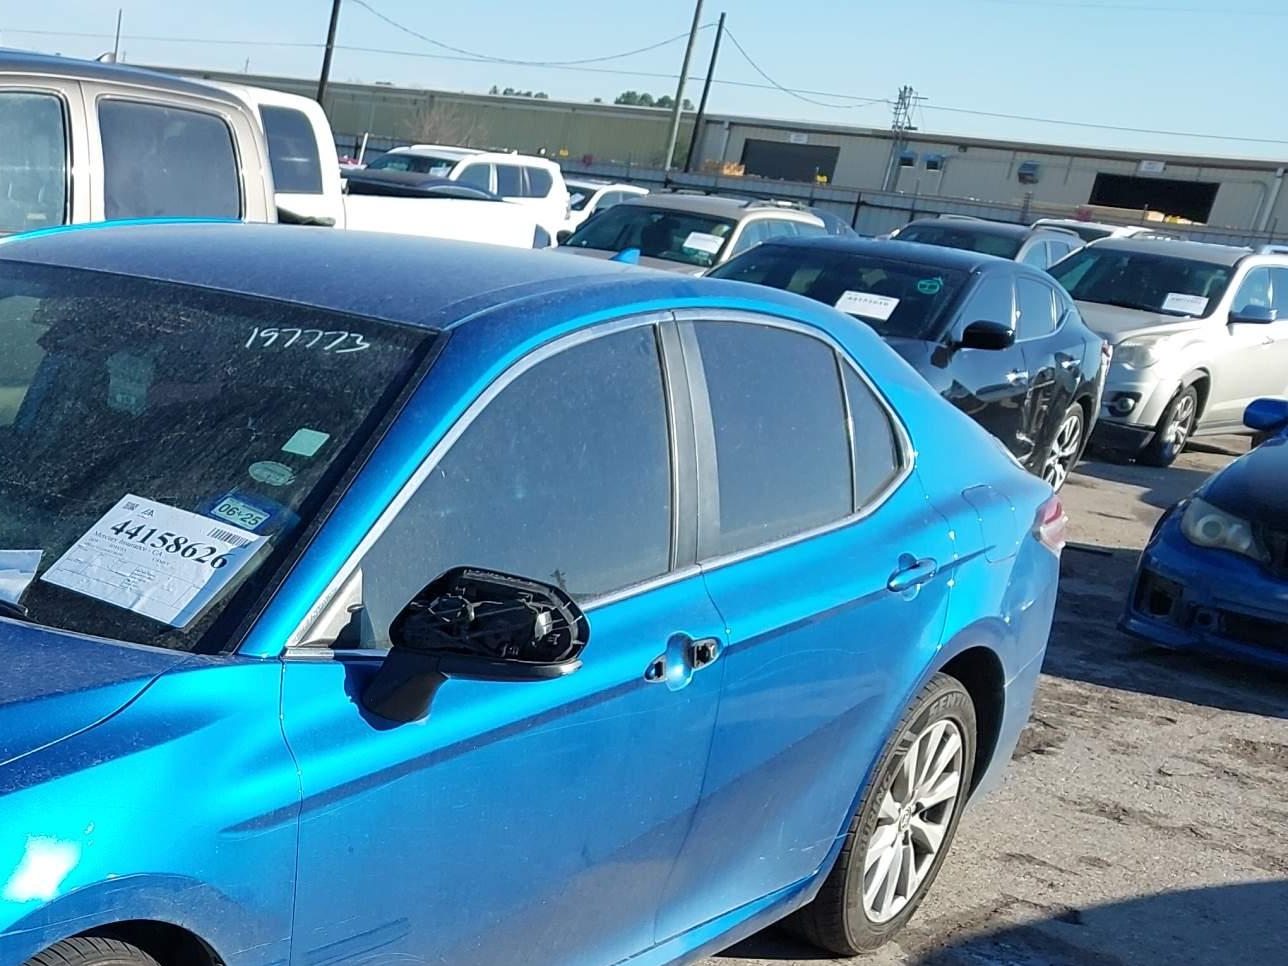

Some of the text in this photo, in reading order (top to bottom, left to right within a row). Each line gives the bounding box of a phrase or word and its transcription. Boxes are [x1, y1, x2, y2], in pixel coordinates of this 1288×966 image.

[245, 327, 371, 354] 197773
[218, 503, 263, 526] 06 25
[110, 519, 236, 569] 44158626
